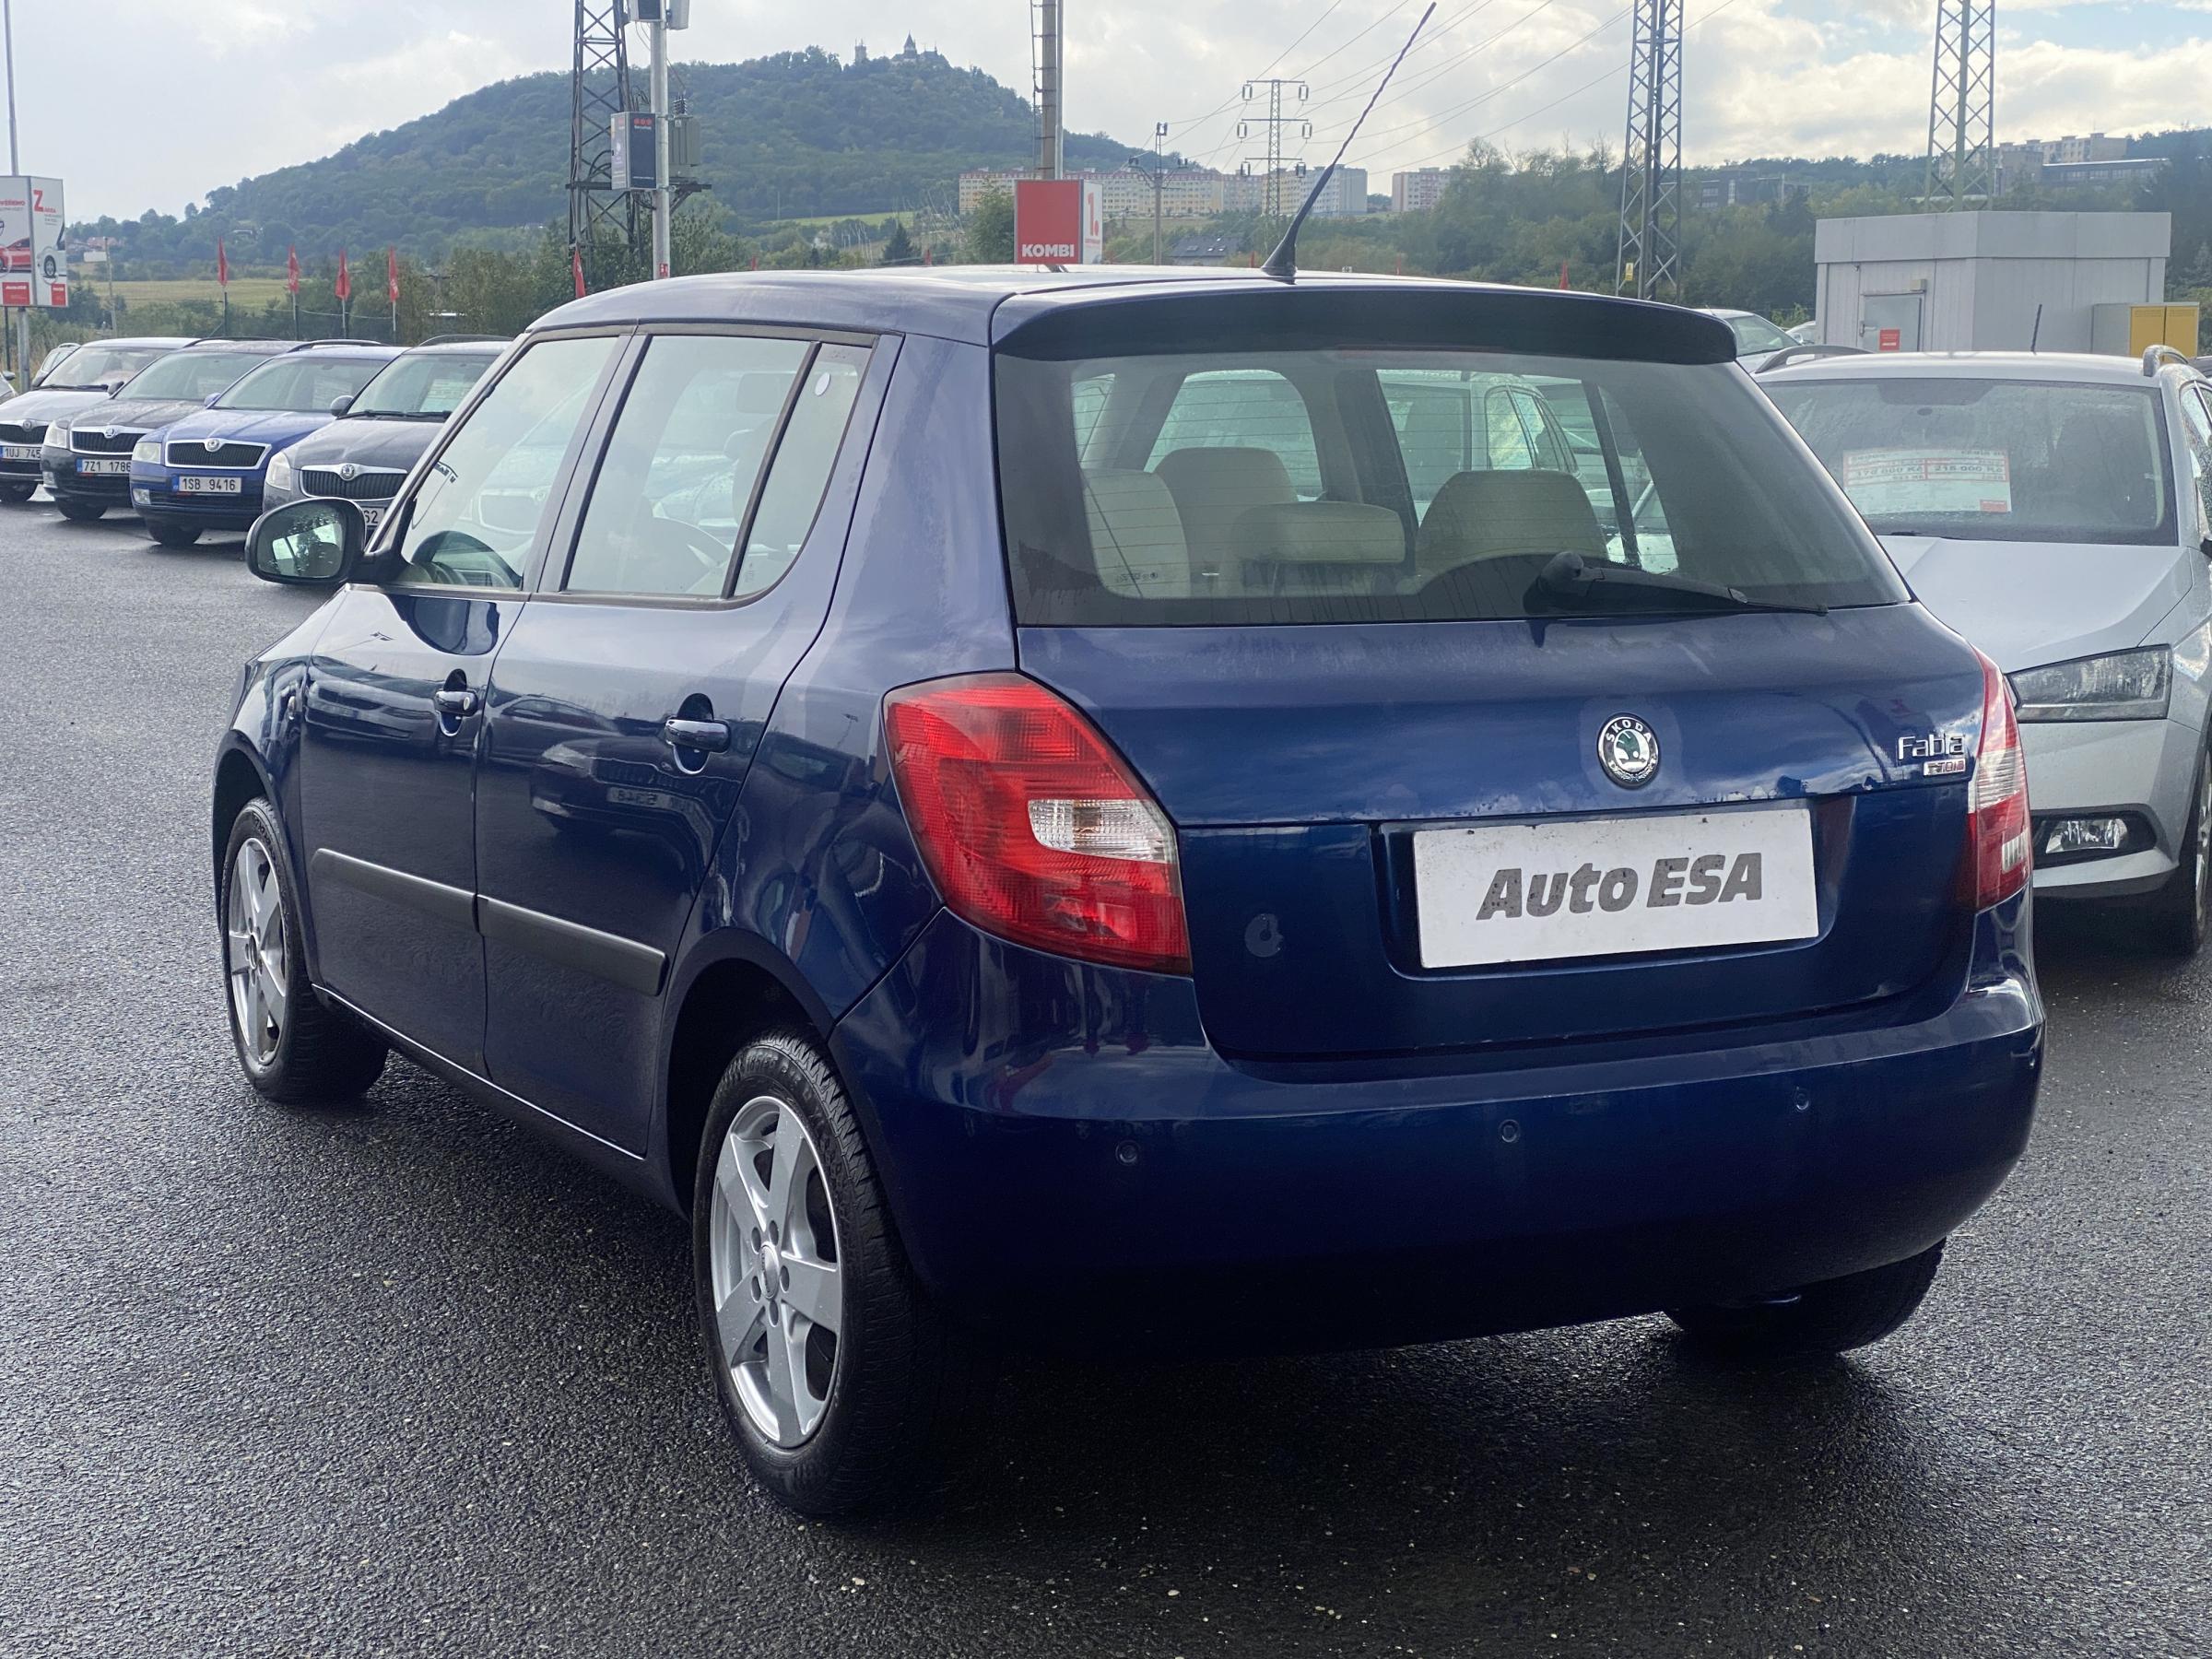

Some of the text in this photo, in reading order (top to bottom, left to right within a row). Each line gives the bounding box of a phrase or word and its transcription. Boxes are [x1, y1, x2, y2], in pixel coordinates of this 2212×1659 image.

[1021, 243, 1075, 258] KOMBI
[6, 448, 19, 458] 1UJ
[84, 461, 101, 472] 7Z1
[182, 478, 236, 491] 1SB 9416
[1898, 731, 1965, 759] Fabia
[1476, 853, 1762, 921] Auto ESA
